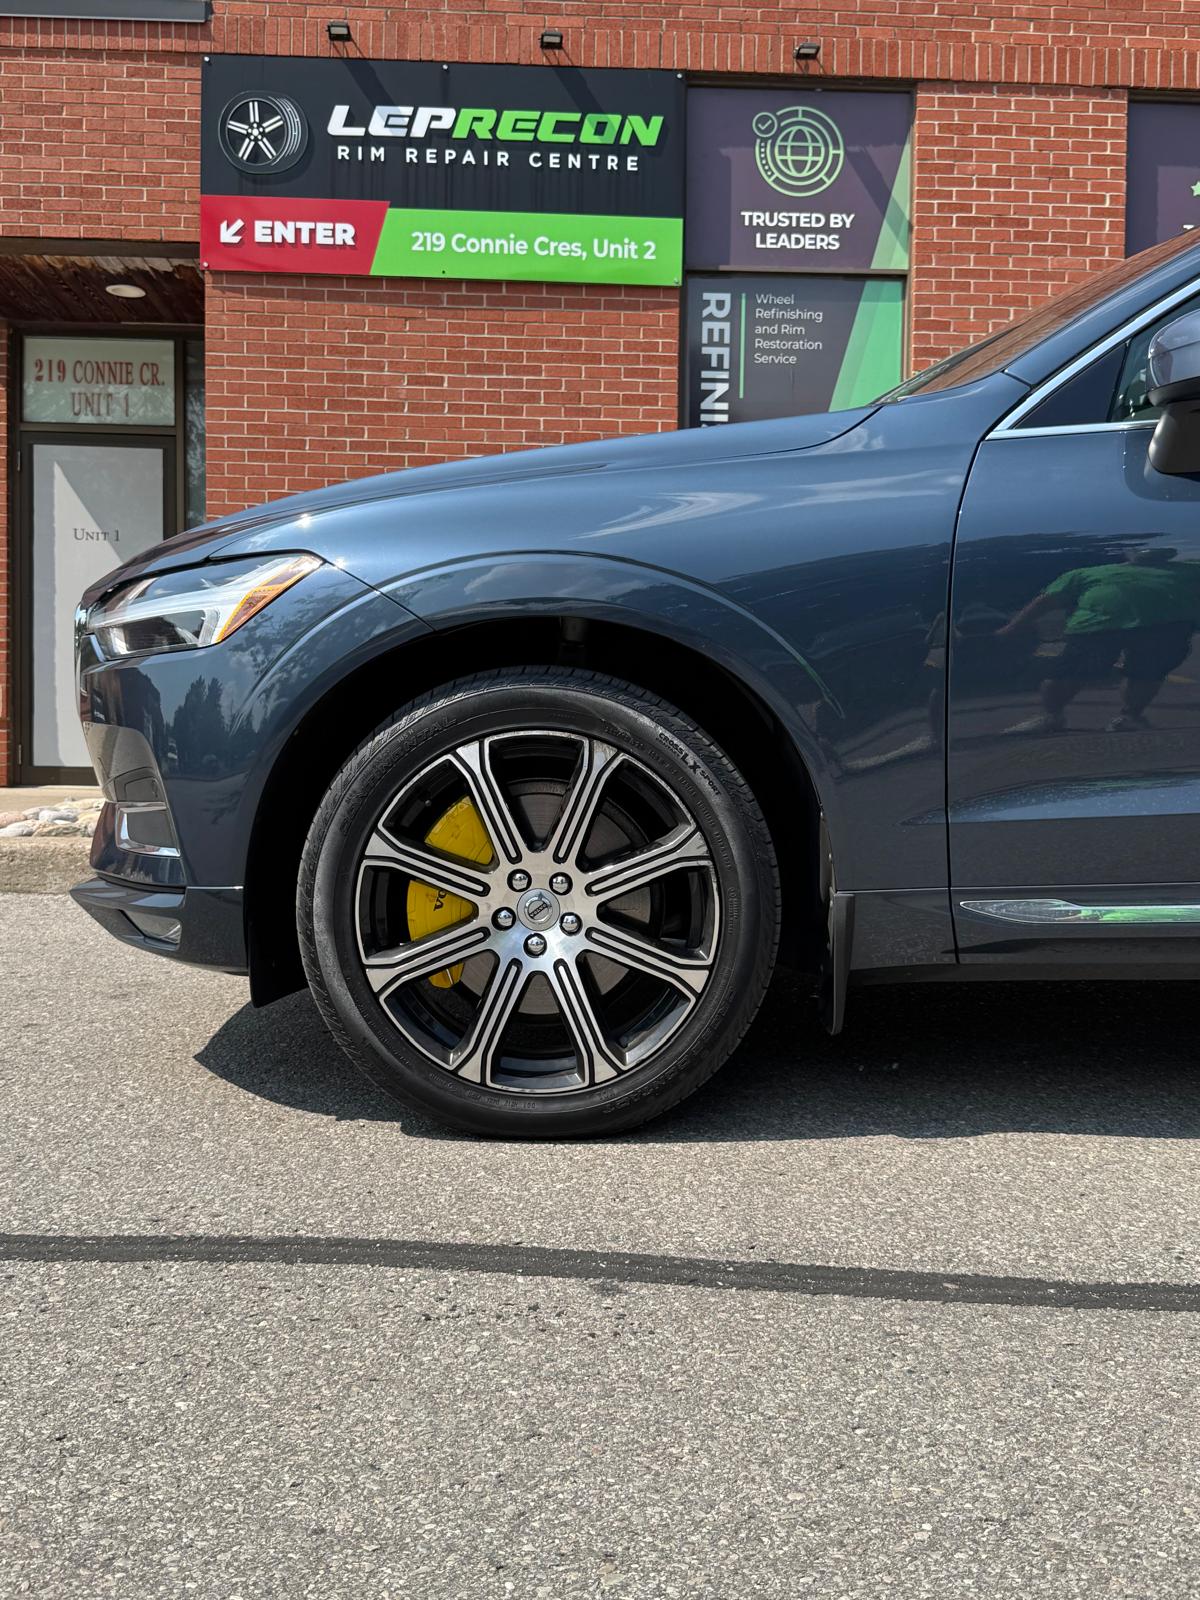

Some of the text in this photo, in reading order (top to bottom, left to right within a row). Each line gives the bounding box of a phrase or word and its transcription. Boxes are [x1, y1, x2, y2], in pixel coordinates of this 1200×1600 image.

[327, 105, 664, 146] LEPRECON
[337, 146, 638, 171] RIM REPAIR CENTRE
[740, 211, 855, 229] TRUSTED BY
[254, 220, 355, 246] ENTER
[755, 232, 840, 250] LEADERS
[411, 232, 656, 261] 219 Connie Cres, Unit 2
[756, 293, 795, 305] Wheel
[755, 308, 823, 323] Refinishing
[754, 324, 805, 335] and Rim
[754, 338, 822, 351] Restoration
[700, 292, 732, 428] REFINI
[753, 353, 797, 364] Service
[34, 358, 165, 387] 219 CONNIE CR.
[71, 391, 130, 417] UNIT 1
[114, 529, 120, 542] 1
[658, 732, 685, 757] CROSS
[699, 770, 722, 796] SPORT
